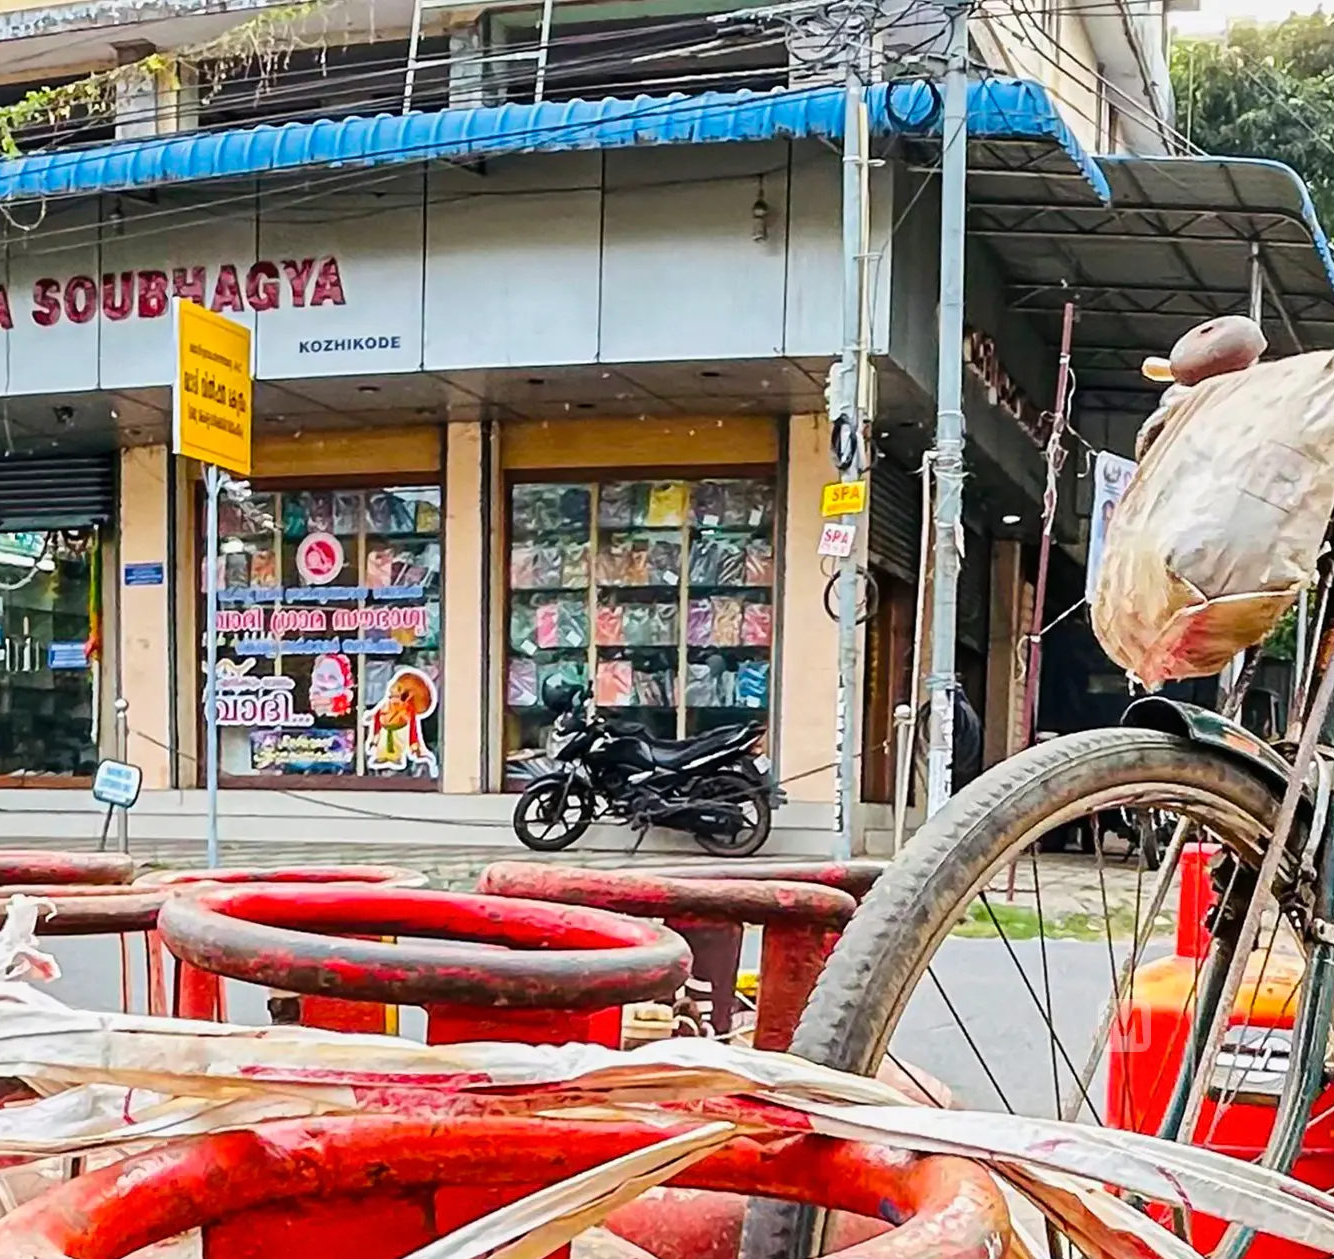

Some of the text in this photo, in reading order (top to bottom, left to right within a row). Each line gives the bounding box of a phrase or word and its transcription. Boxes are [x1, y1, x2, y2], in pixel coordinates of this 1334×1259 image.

[32, 255, 347, 326] SOUBHAGYA
[298, 336, 401, 354] KOZHIKODE
[832, 486, 860, 501] SPA
[824, 528, 849, 544] SPA
